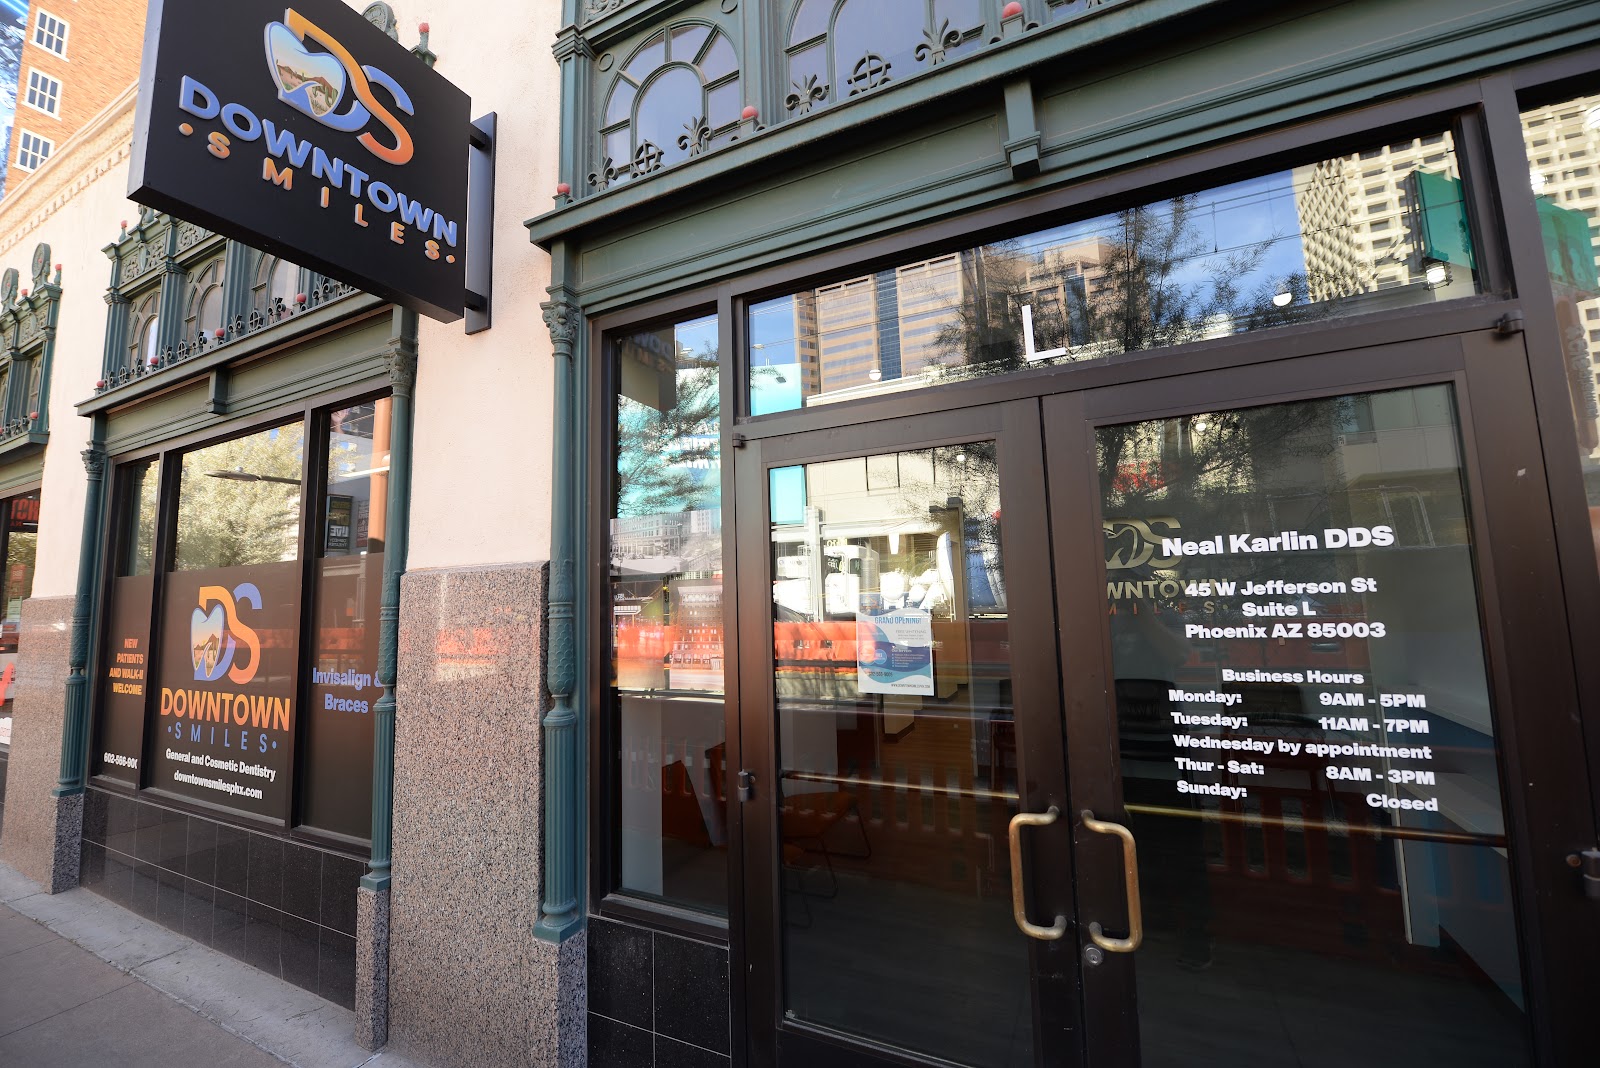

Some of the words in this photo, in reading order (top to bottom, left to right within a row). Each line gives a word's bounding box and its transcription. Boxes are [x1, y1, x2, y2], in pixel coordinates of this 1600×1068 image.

[179, 75, 458, 247] DOWNTOWN
[1021, 304, 1067, 361] L
[1162, 535, 1223, 557] Neal
[1229, 531, 1318, 553] Karlin
[1324, 525, 1395, 549] DDS
[1184, 582, 1211, 597] 45
[1214, 581, 1236, 596] W
[1240, 580, 1346, 596] Jefferson
[1350, 577, 1378, 593] St
[875, 616, 893, 624] GRAND
[1242, 602, 1298, 617] Suite
[1302, 602, 1317, 616] L
[1185, 624, 1268, 639] Phoenix
[1271, 623, 1303, 638] AZ
[1307, 622, 1386, 638] 85003
[124, 638, 139, 648] NEW
[116, 653, 144, 664] PATIENTS
[109, 667, 122, 678] AND
[312, 667, 371, 691] Invisalign
[1222, 669, 1304, 683] Business
[1306, 670, 1365, 684] Hours
[112, 683, 143, 695] WELCOME
[1168, 689, 1242, 706] Monday:
[1319, 692, 1365, 707] 9AM
[1379, 694, 1427, 708] 5PM
[160, 687, 291, 732] DOWNTOWN
[324, 693, 369, 714] Braces
[1170, 712, 1248, 730] Tuesday:
[1318, 717, 1369, 731] 11AM
[1383, 719, 1430, 734] 7PM
[1172, 734, 1274, 754] Wednesday
[1277, 739, 1301, 756] by
[1305, 742, 1432, 760] appointment
[165, 747, 191, 763] General
[190, 754, 204, 766] and
[204, 754, 239, 773] Cosmetic
[238, 761, 277, 783] Dentistry
[1174, 757, 1215, 772] Thur
[1227, 760, 1265, 775] Sat:
[1325, 766, 1372, 781] 8AM
[1387, 769, 1436, 785] 3PM
[173, 769, 263, 799] downtownsmilesphx.com
[1176, 780, 1248, 800] Sunday:
[1366, 793, 1439, 811] Closed
